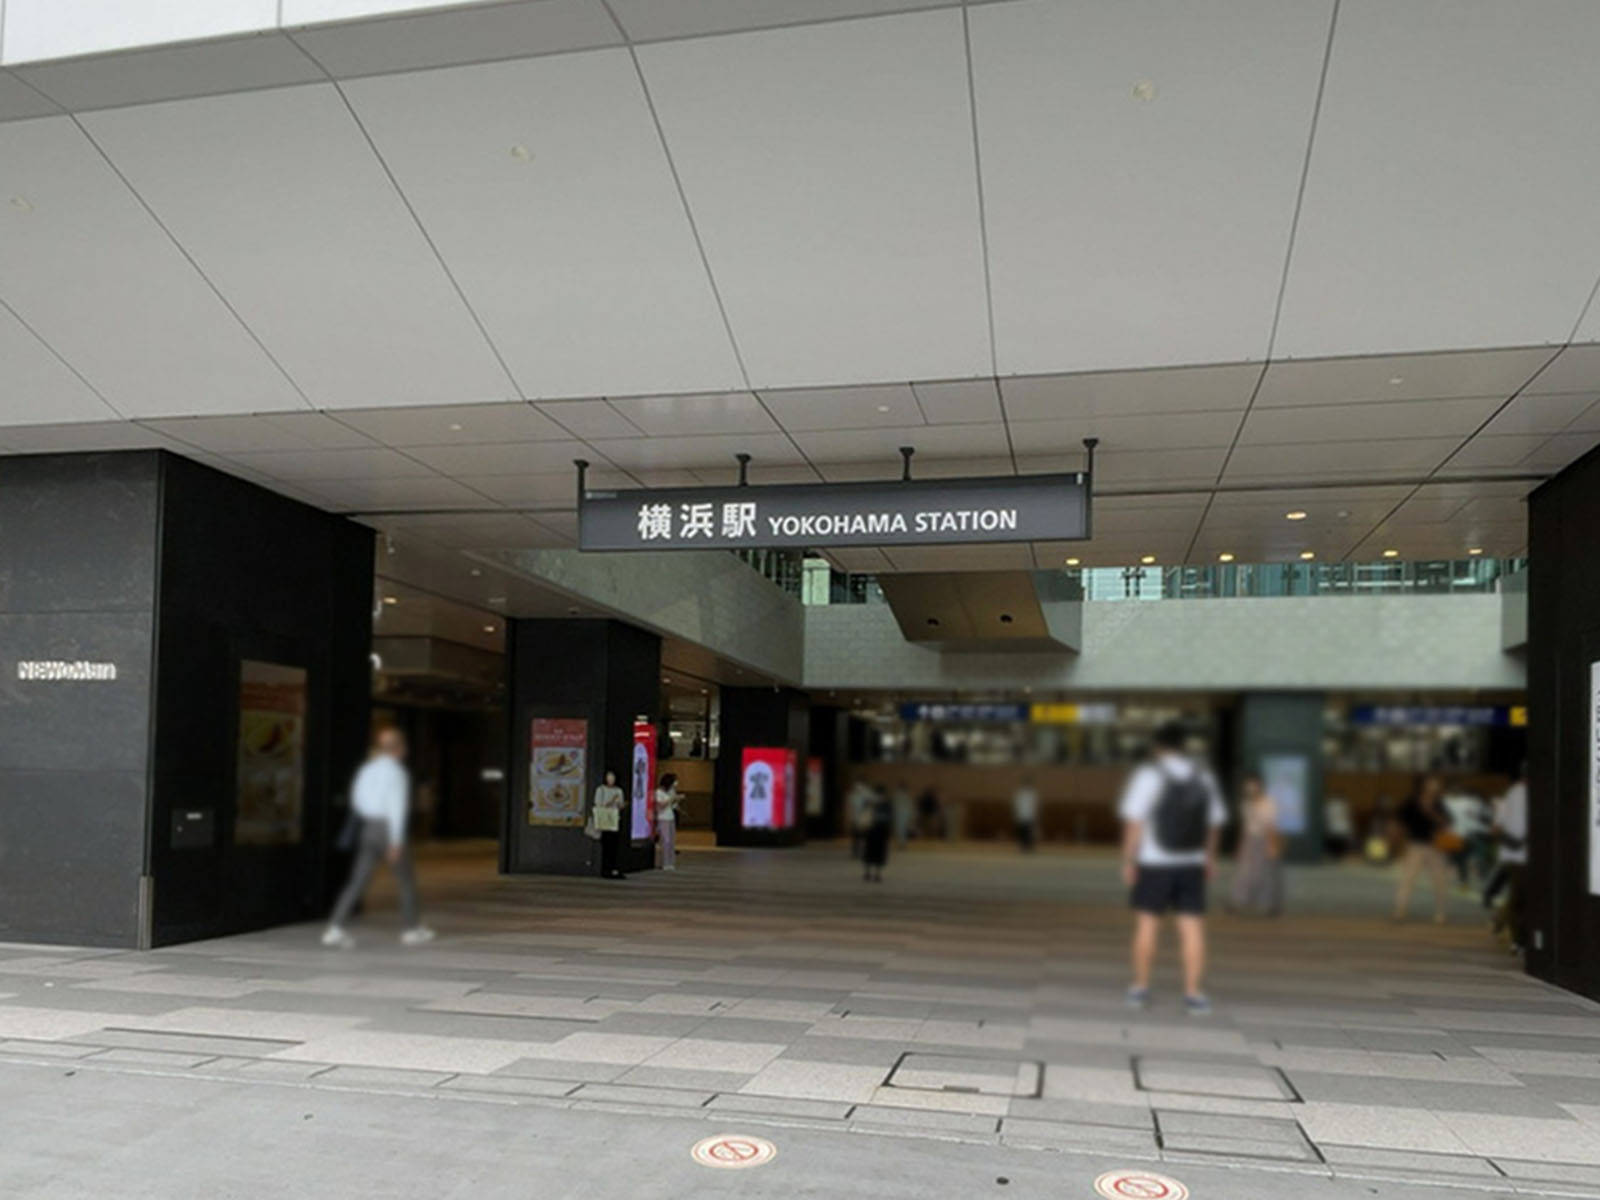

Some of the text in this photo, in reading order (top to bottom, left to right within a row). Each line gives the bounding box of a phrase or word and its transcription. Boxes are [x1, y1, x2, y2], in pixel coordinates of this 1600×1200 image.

[637, 502, 1018, 540] 横浜駅 YOKOHAMA STATION
